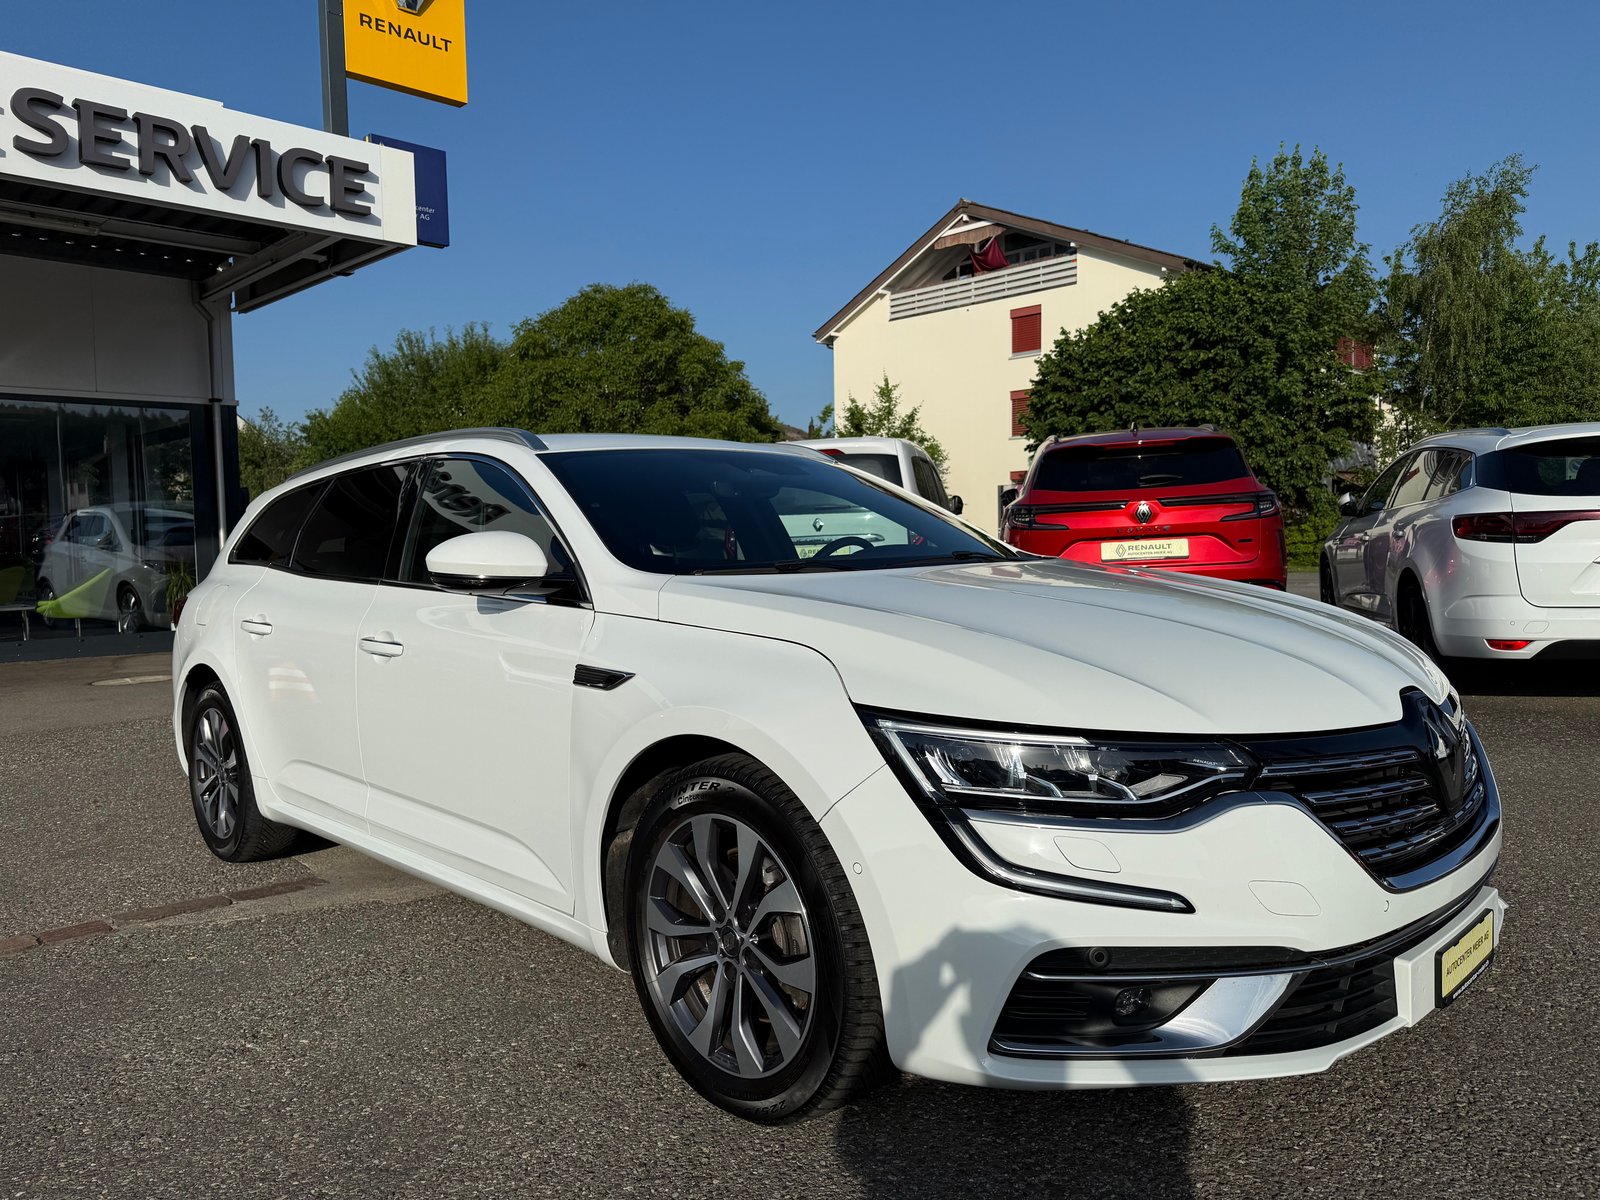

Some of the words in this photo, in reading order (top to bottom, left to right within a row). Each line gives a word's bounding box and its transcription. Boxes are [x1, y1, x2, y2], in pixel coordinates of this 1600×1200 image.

[359, 12, 452, 52] RENAULT
[9, 86, 373, 217] SERVICE
[420, 213, 430, 221] AG
[1127, 543, 1172, 551] RENAULT
[668, 781, 721, 799] INTER
[1446, 946, 1473, 976] AUTOCENTER
[1472, 935, 1484, 953] MEIER
[1483, 930, 1490, 941] AG
